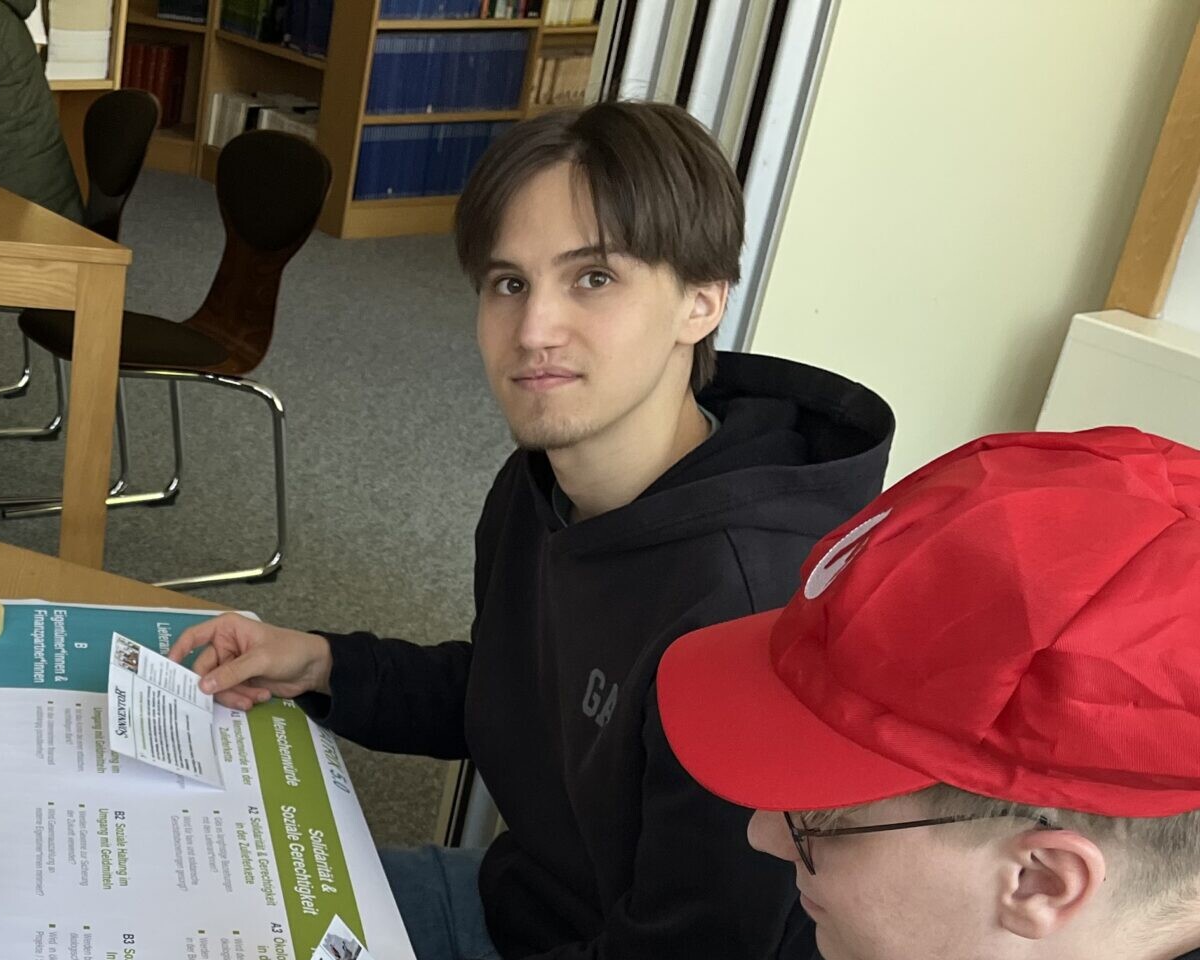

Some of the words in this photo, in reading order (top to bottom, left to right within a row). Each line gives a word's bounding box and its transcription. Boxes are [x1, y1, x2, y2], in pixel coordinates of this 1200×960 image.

[272, 716, 300, 786] Menschenwürde
[97, 809, 108, 835] Umgang
[115, 811, 125, 820] B2
[248, 806, 260, 814] A2
[250, 818, 267, 849] Solidarität
[281, 805, 302, 840] Soziale
[100, 837, 110, 847] mit
[116, 824, 127, 846] Soziale
[236, 831, 248, 841] der
[117, 849, 128, 876] Haltung
[238, 842, 256, 884] Zulieferkette
[309, 829, 335, 881] Solidarität
[101, 849, 112, 889] Geldmitteln
[288, 843, 318, 915] Gerechtigkeit
[120, 878, 129, 886] im
[258, 859, 277, 906] Gerechtigkeit
[320, 884, 338, 893] &
[123, 934, 135, 945] B3
[270, 922, 283, 933] A3
[258, 945, 269, 953] in
